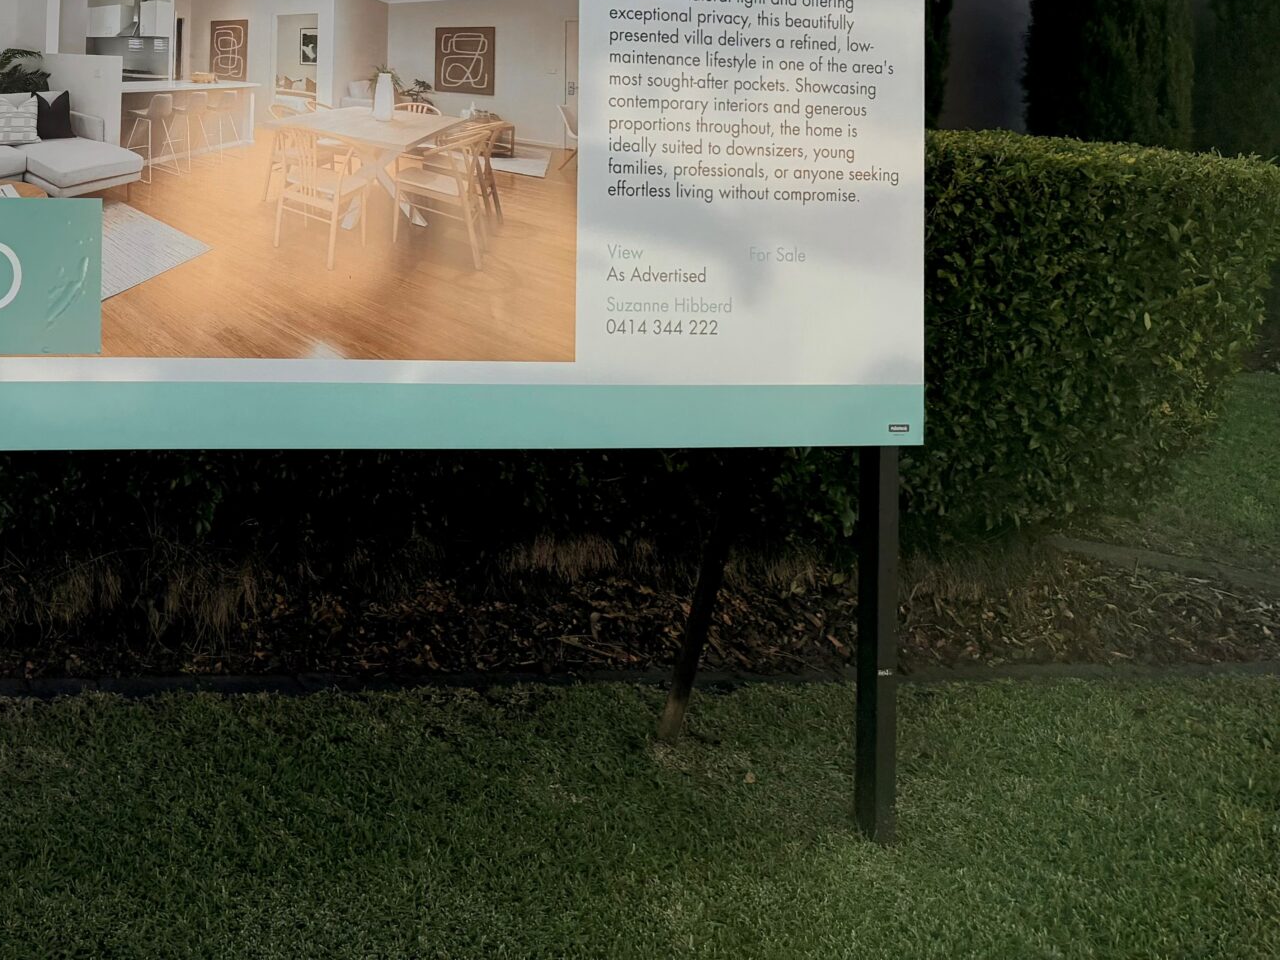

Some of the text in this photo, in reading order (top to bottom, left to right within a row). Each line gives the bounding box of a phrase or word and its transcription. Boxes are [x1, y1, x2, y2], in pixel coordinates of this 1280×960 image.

[609, 7, 854, 34] exceptional privacy, this beautifully
[610, 28, 874, 53] presented villa delivers a refined, low-
[609, 50, 894, 75] maintenance lifestyle in one of the area's
[609, 72, 876, 100] most sought-after pockets. Showcasing
[608, 95, 867, 119] contemporary interiors and generous
[609, 116, 858, 139] proportions throughout, the home is
[609, 135, 855, 164] ideally suited to downsizers, young
[608, 157, 899, 186] families, professionals, or anyone seeking
[608, 179, 860, 206] effortless living without compromise.
[607, 244, 643, 260] View
[749, 246, 806, 262] For Sale
[606, 265, 706, 283] As Advertised
[606, 296, 732, 313] Suzanne Hibberd
[606, 318, 718, 335] 0414 344 222
